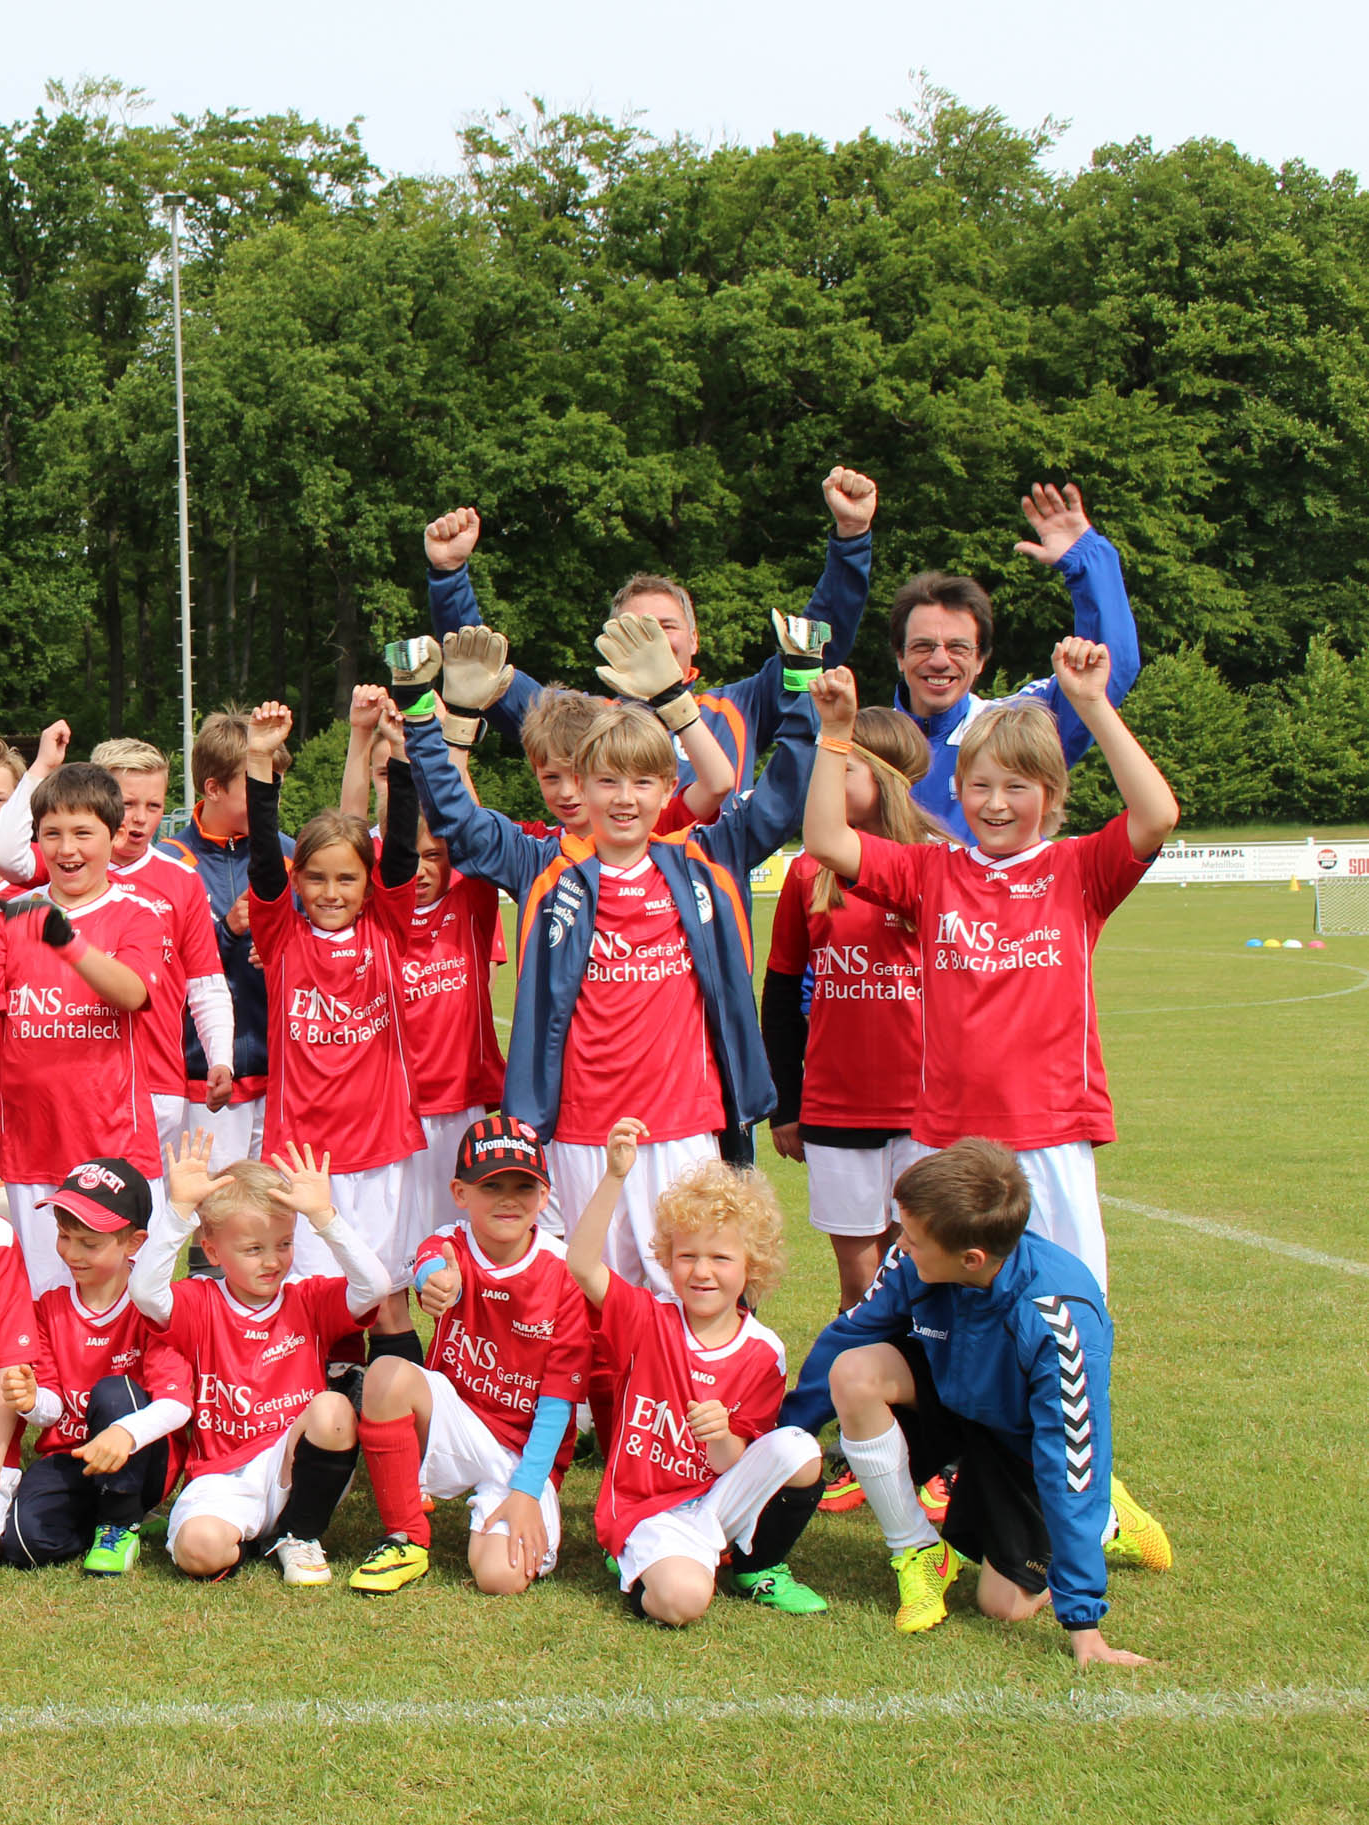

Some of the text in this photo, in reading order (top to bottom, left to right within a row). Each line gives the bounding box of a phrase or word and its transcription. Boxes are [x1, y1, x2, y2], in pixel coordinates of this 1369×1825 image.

[1159, 849, 1245, 859] ROBERT PIMPL
[985, 871, 1009, 883] JAKO
[617, 886, 646, 897] JAKO
[331, 948, 357, 959] JAKO
[934, 949, 949, 971] &
[20, 1018, 121, 1040] Buchtaleck
[289, 1008, 391, 1045] & Buchtaleck
[474, 1135, 537, 1157] Krombacher
[481, 1288, 511, 1301] JAKO
[85, 1336, 110, 1347] JAKO
[243, 1329, 270, 1340] JAKO
[442, 1345, 457, 1366] &
[253, 1387, 315, 1415] Getränke
[197, 1408, 213, 1430] &
[625, 1432, 644, 1458] &
